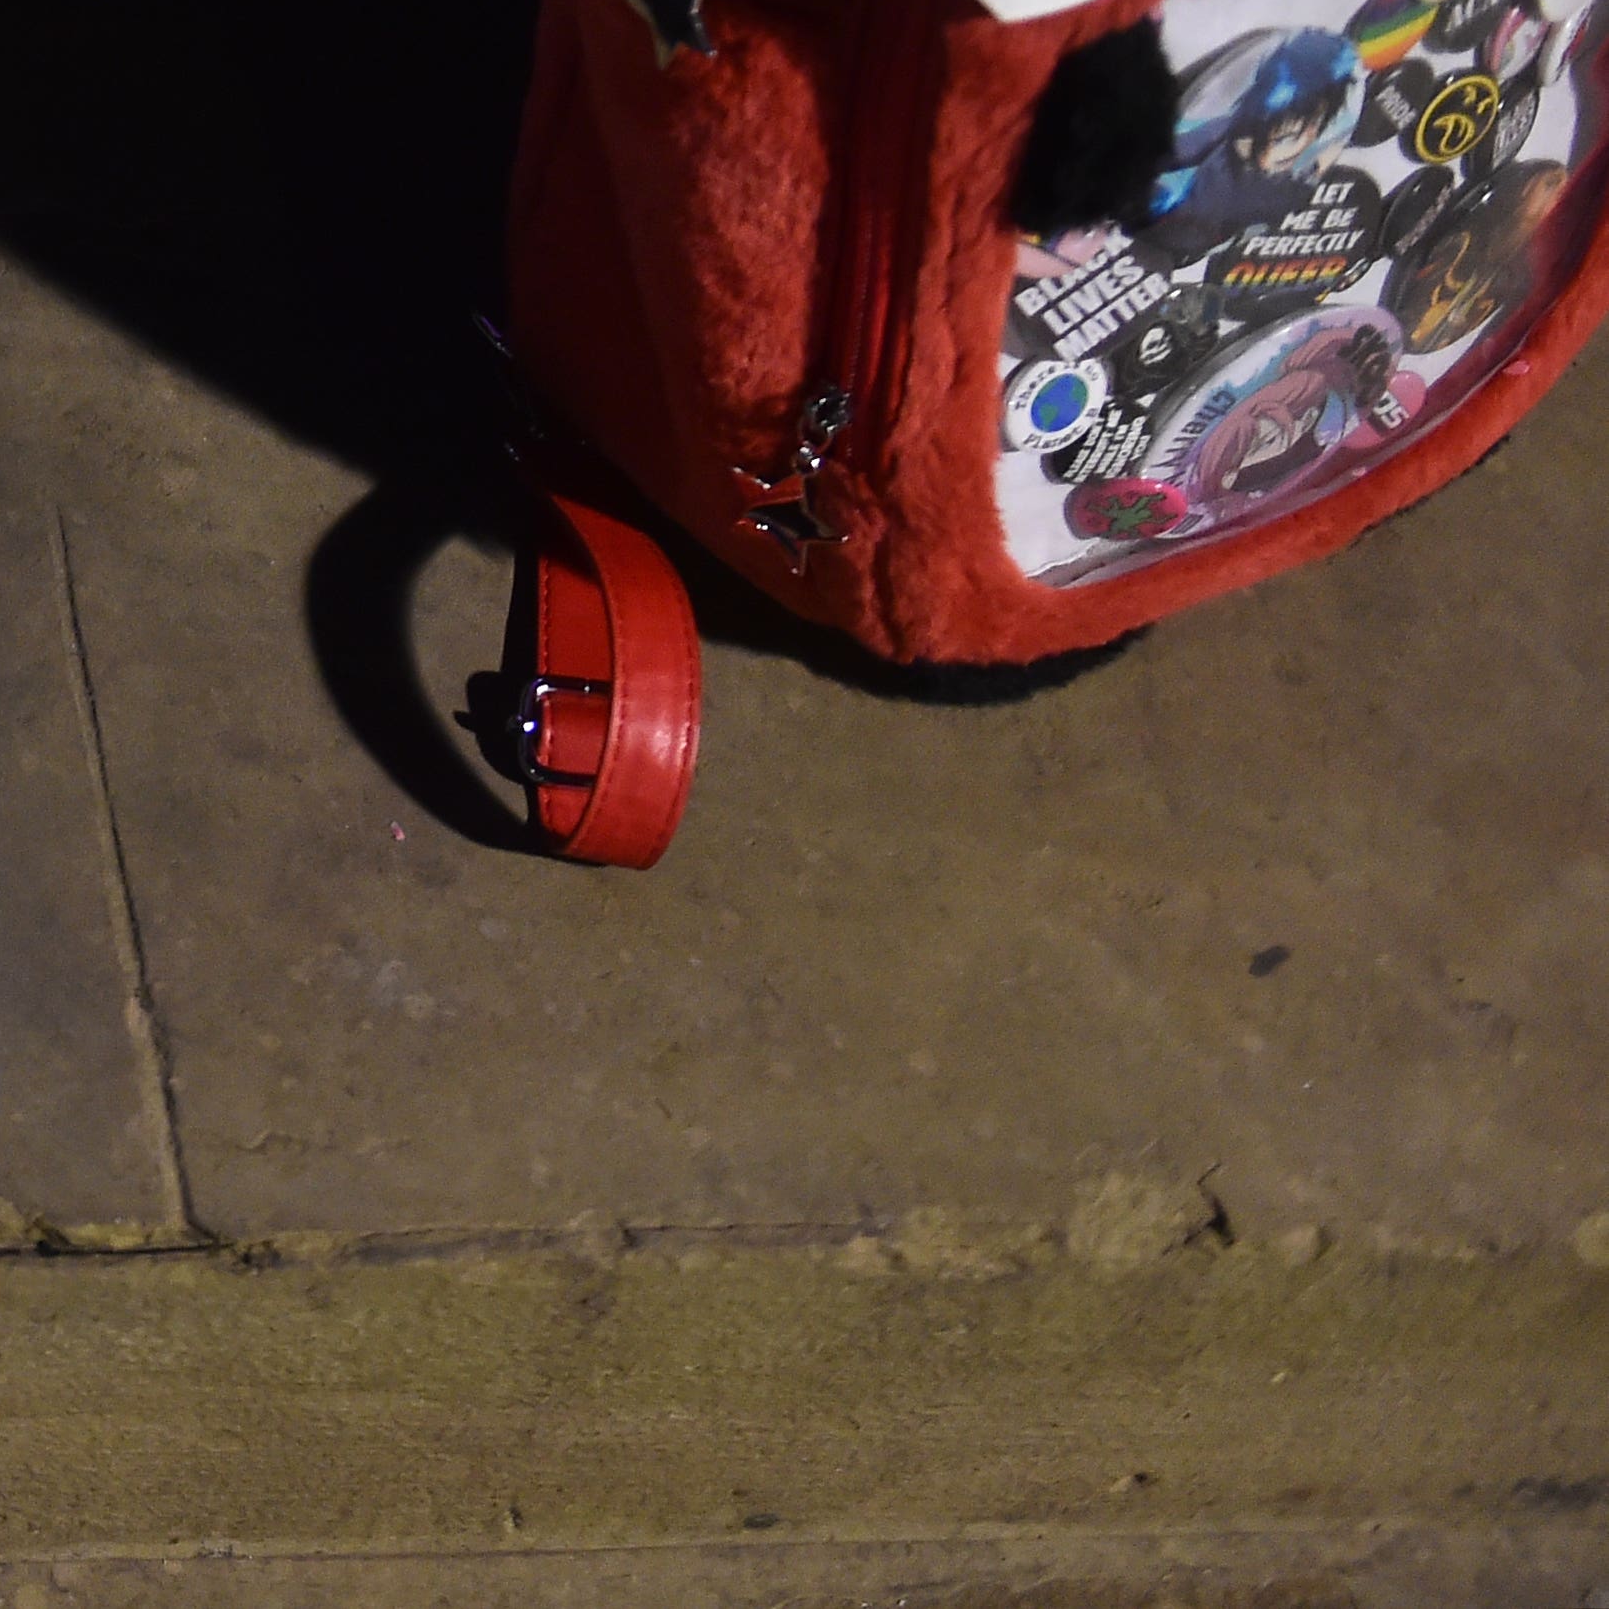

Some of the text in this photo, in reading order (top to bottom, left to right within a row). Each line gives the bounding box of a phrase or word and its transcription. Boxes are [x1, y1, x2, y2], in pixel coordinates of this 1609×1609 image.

[1310, 182, 1355, 205] LET
[1280, 206, 1360, 230] ME BE
[1243, 229, 1365, 256] PERFECTLY
[1043, 255, 1145, 336] LIVES
[1053, 272, 1171, 363] MATTER
[1014, 365, 1055, 410] There
[1023, 425, 1083, 449] Planet
[1129, 434, 1151, 461] YOU
